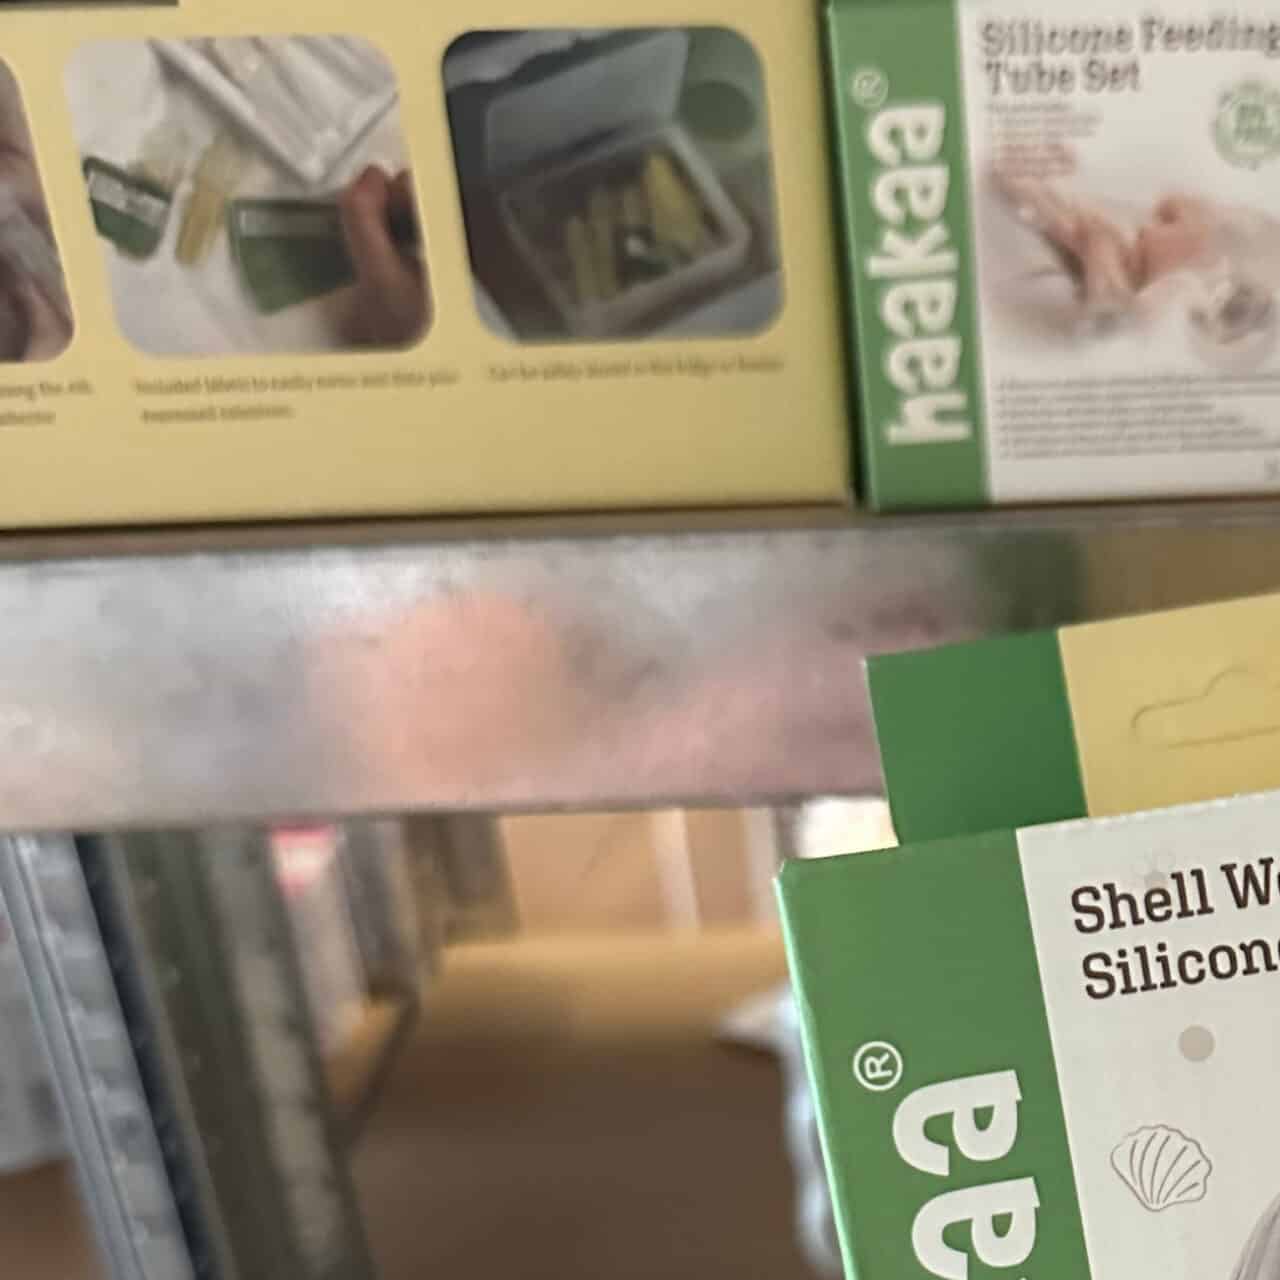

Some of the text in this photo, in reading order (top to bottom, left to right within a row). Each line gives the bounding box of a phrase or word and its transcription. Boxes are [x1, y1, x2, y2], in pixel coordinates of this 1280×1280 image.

[981, 17, 1134, 56] Silicone
[984, 57, 1141, 95] Tube Set
[1071, 867, 1214, 934] Shell
